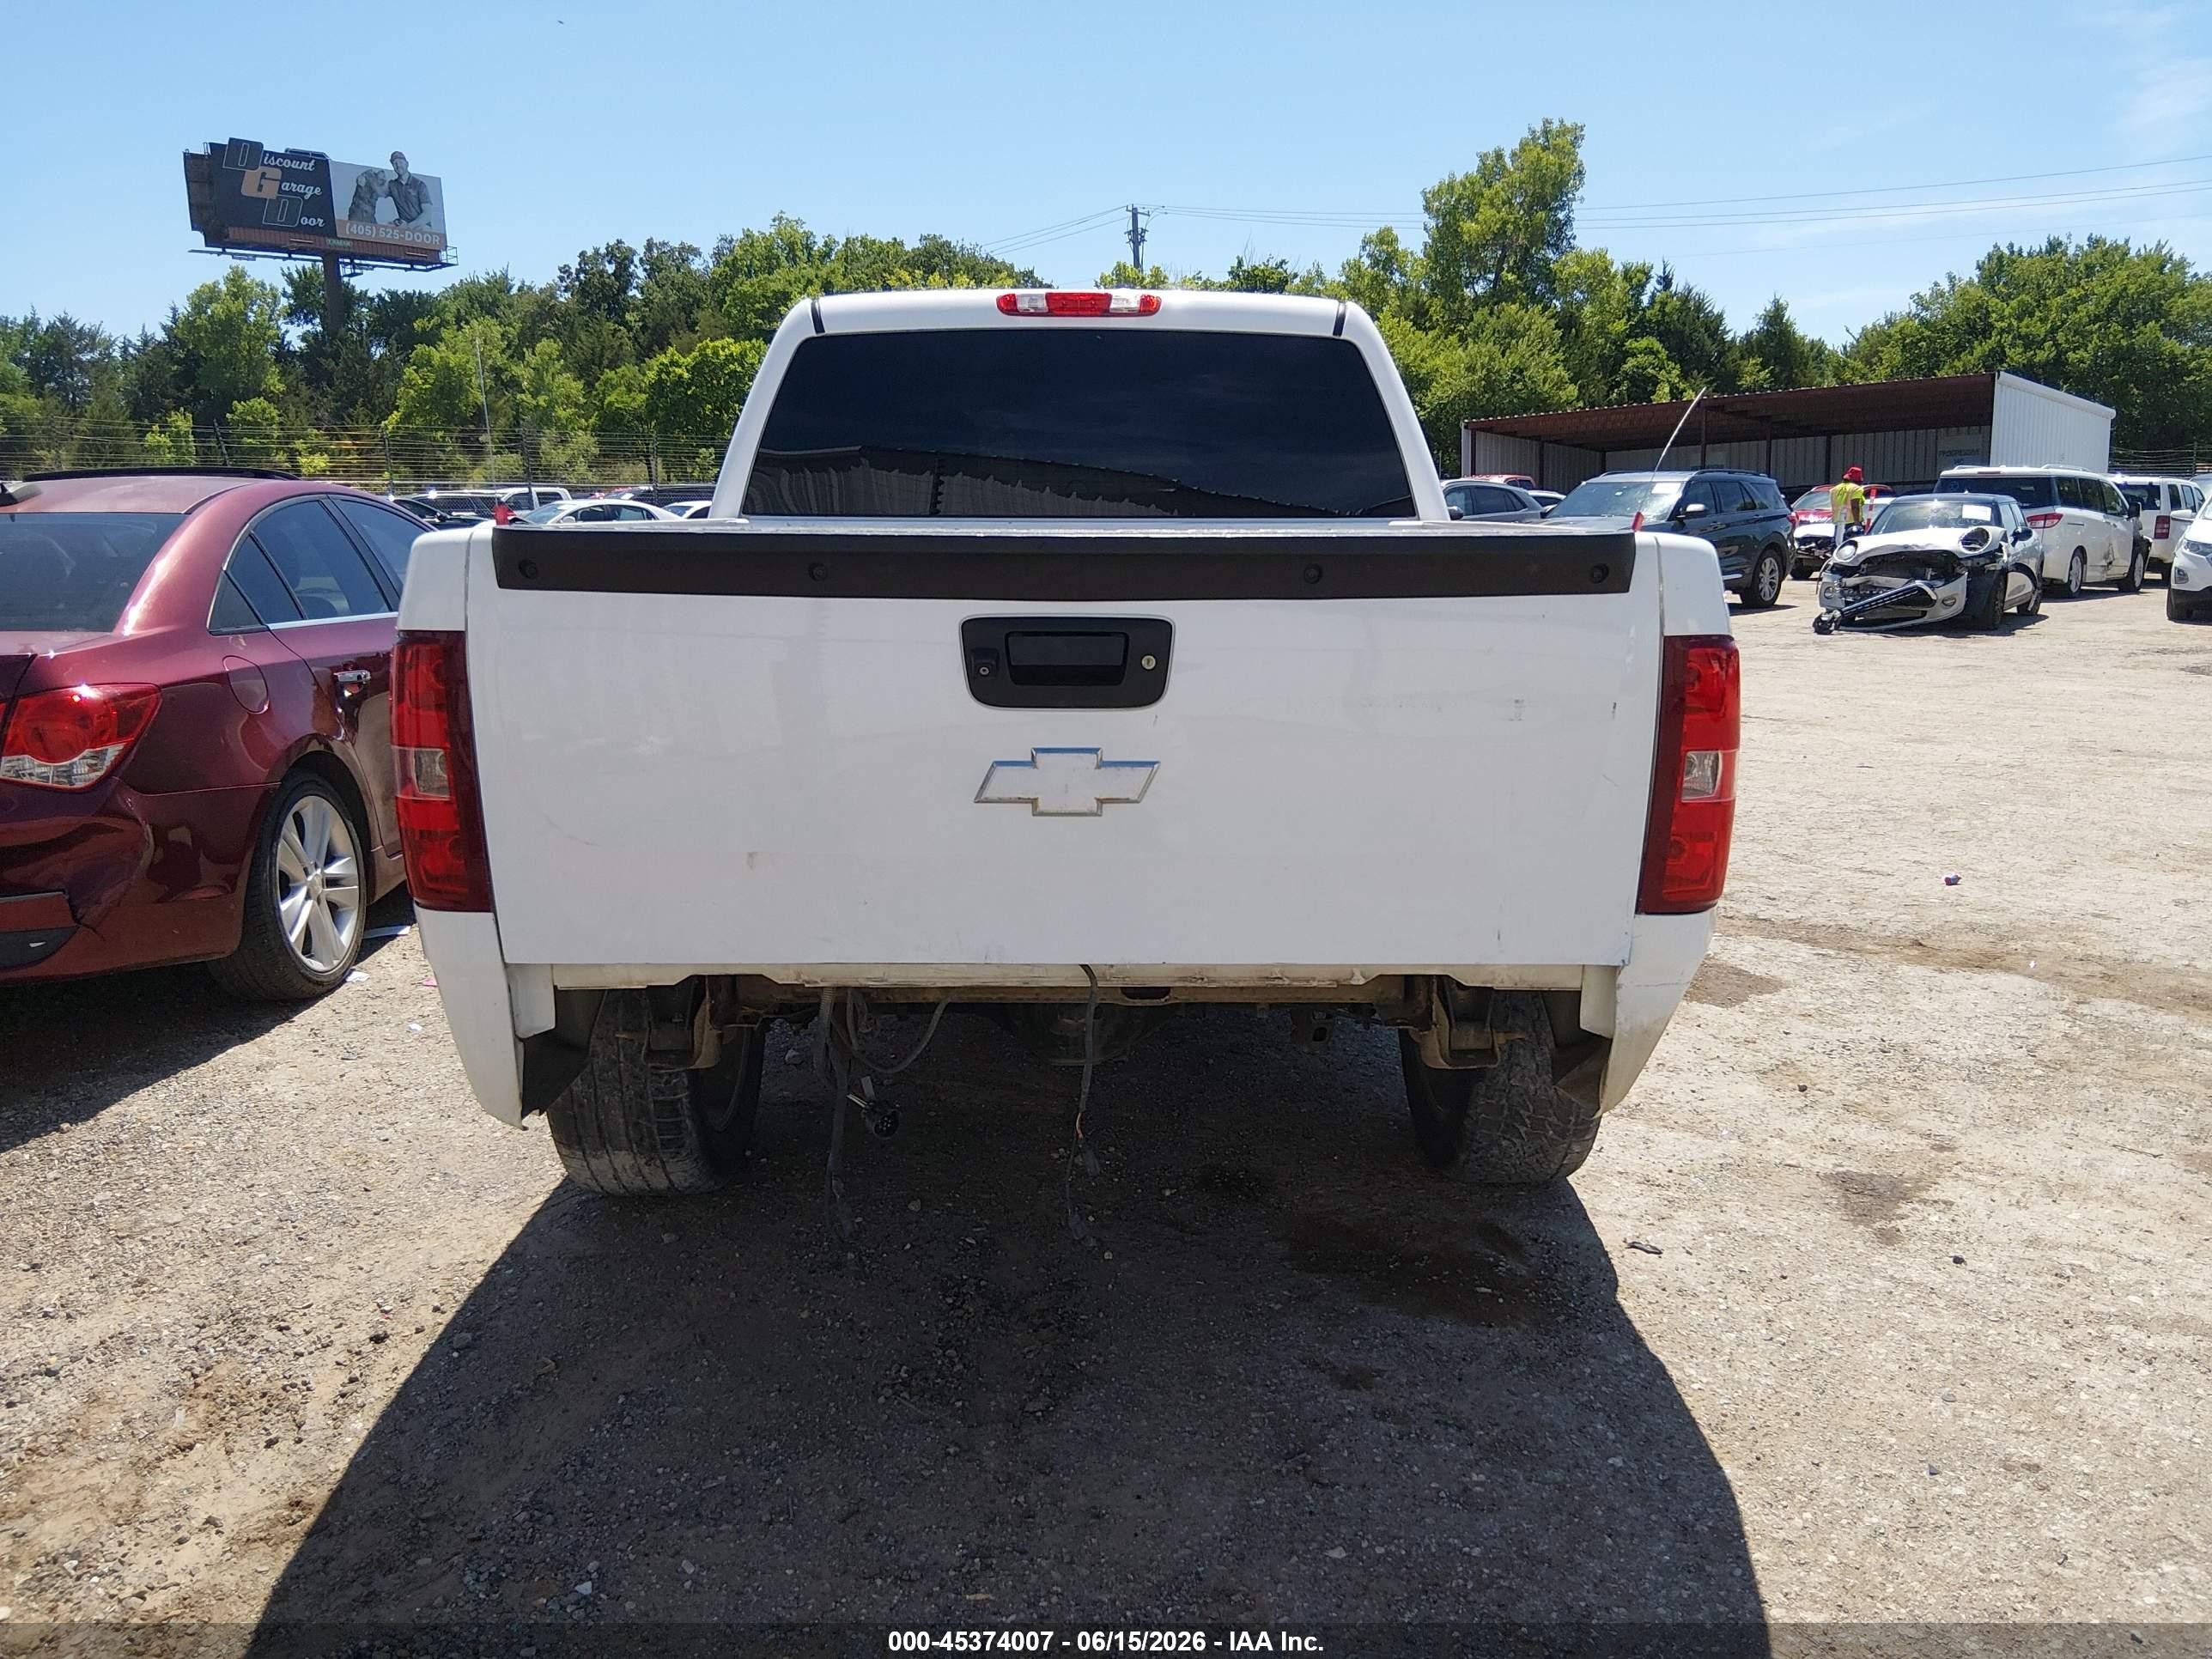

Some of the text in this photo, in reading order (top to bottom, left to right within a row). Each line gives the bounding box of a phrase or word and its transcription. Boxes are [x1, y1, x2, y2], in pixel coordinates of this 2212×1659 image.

[222, 137, 316, 172] Discount
[241, 166, 323, 200] Garage
[262, 194, 325, 228] Door
[345, 223, 441, 245] (405) 525-DOOR
